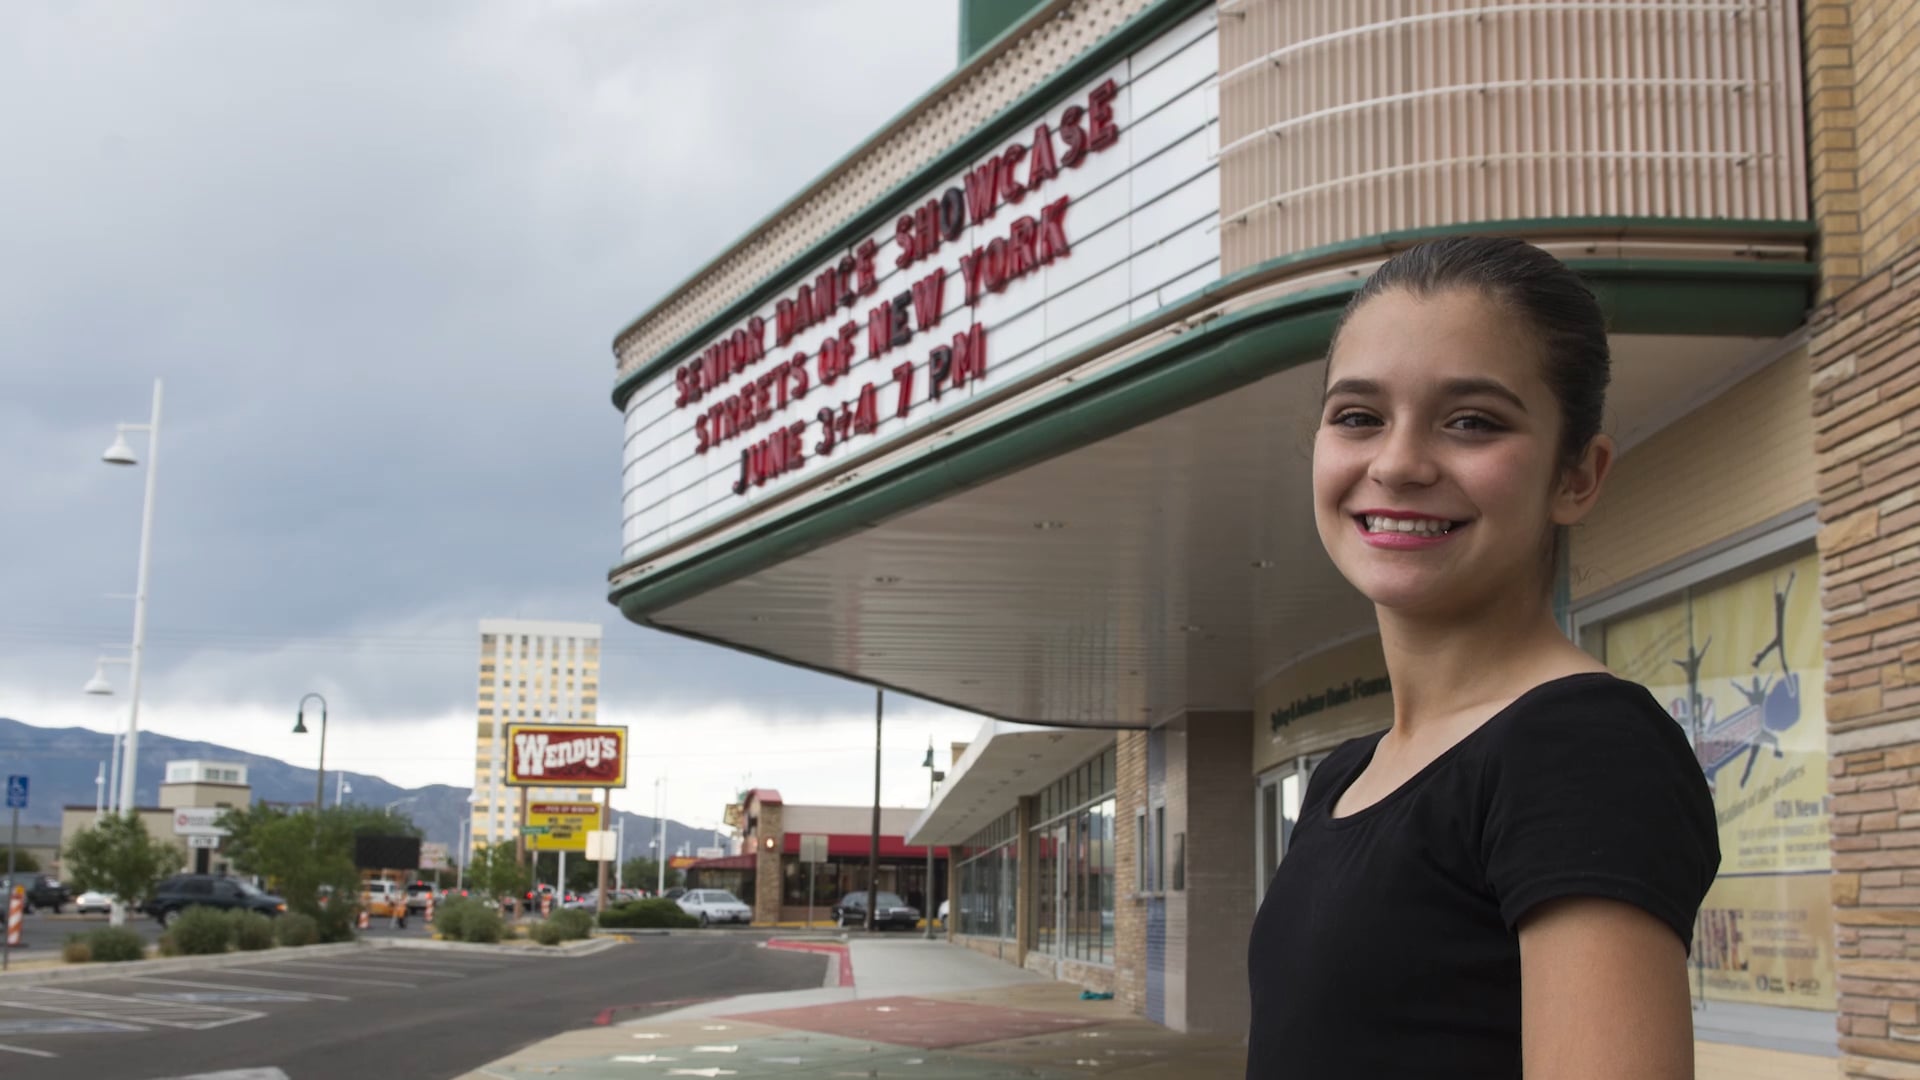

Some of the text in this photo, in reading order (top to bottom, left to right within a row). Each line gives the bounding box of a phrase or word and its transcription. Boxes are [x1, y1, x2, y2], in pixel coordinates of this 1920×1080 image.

[676, 78, 1118, 408] SENIOR DANCE SHOWCASE
[695, 195, 1071, 454] STREETS OF NEW YORK
[733, 419, 806, 495] JUNE
[893, 361, 913, 418] 7
[929, 322, 987, 401] PM
